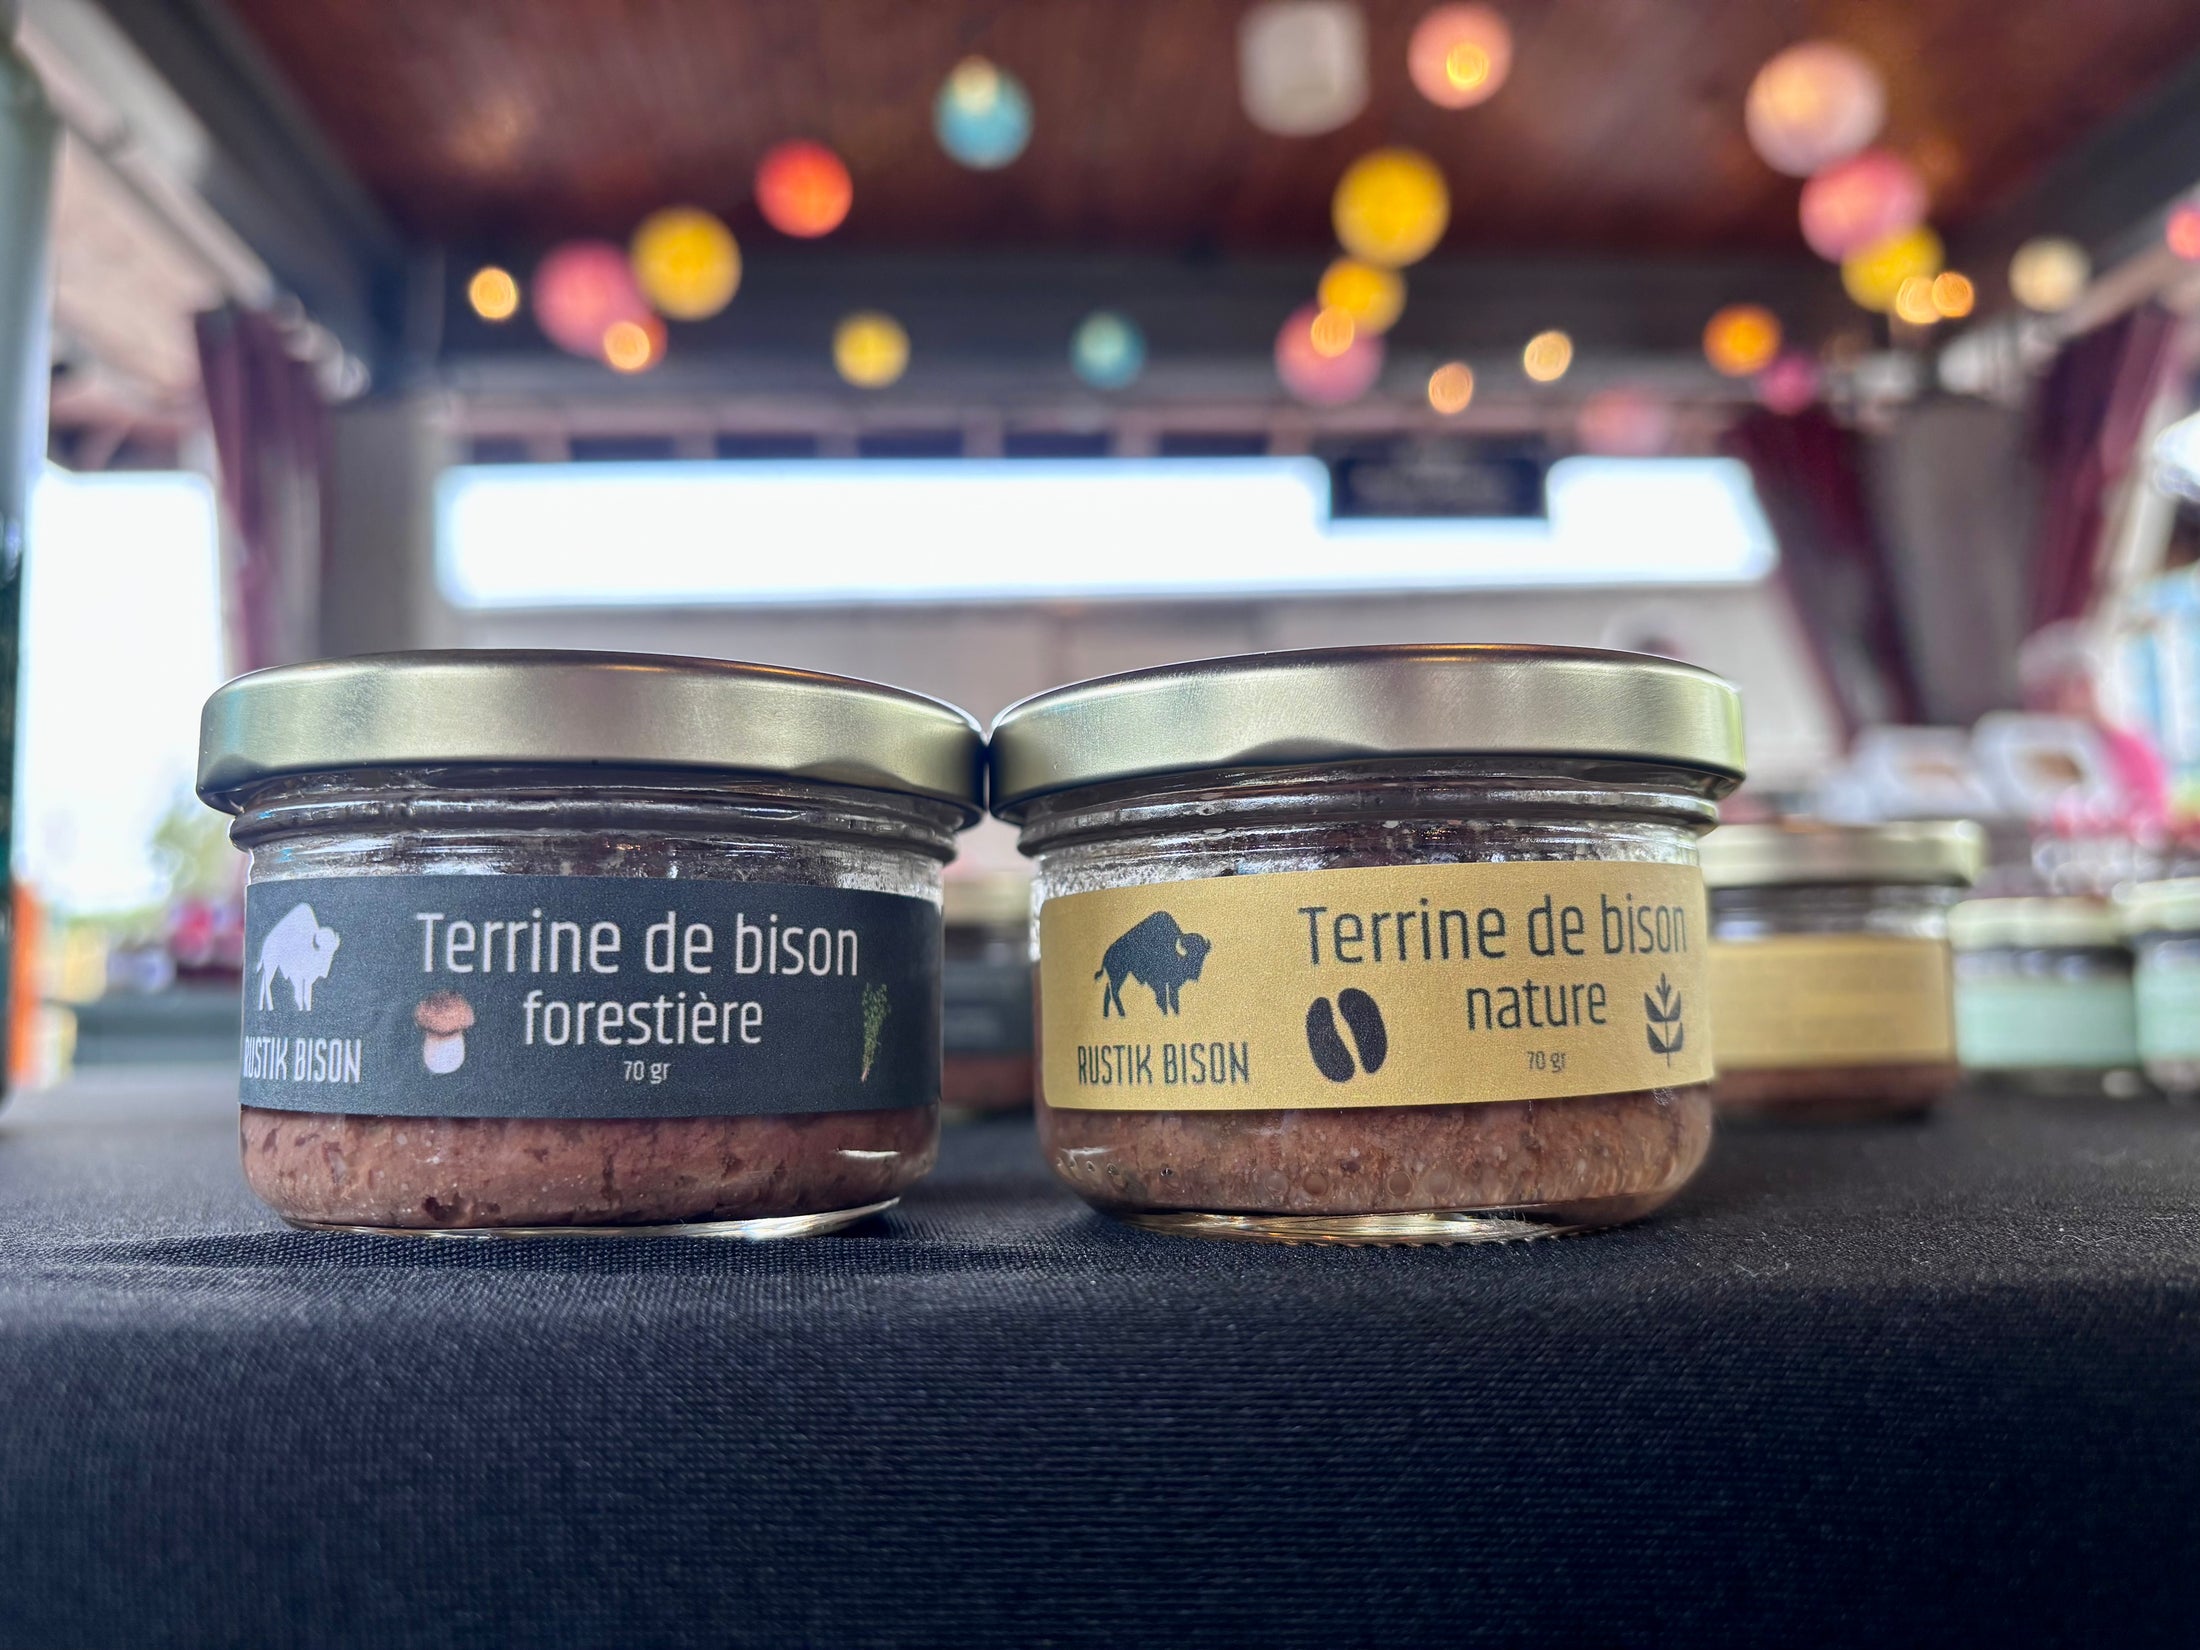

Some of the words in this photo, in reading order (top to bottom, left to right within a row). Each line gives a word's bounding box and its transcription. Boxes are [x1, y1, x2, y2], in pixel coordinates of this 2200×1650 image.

[416, 908, 621, 974] Terrine
[645, 910, 714, 974] de
[735, 913, 858, 976] bison
[1298, 897, 1506, 965] Terrine
[1527, 893, 1585, 956] de
[1600, 892, 1688, 954] bison
[523, 989, 763, 1046] forestière
[1466, 978, 1607, 1031] nature
[243, 1035, 288, 1081] RUSTIK
[293, 1037, 362, 1084] BISON
[623, 1061, 645, 1082] 70
[650, 1062, 672, 1084] gr
[1077, 1044, 1152, 1086] RUSTIK
[1163, 1041, 1250, 1086] BISON
[1527, 1051, 1545, 1071] 70
[1549, 1052, 1566, 1073] gr
